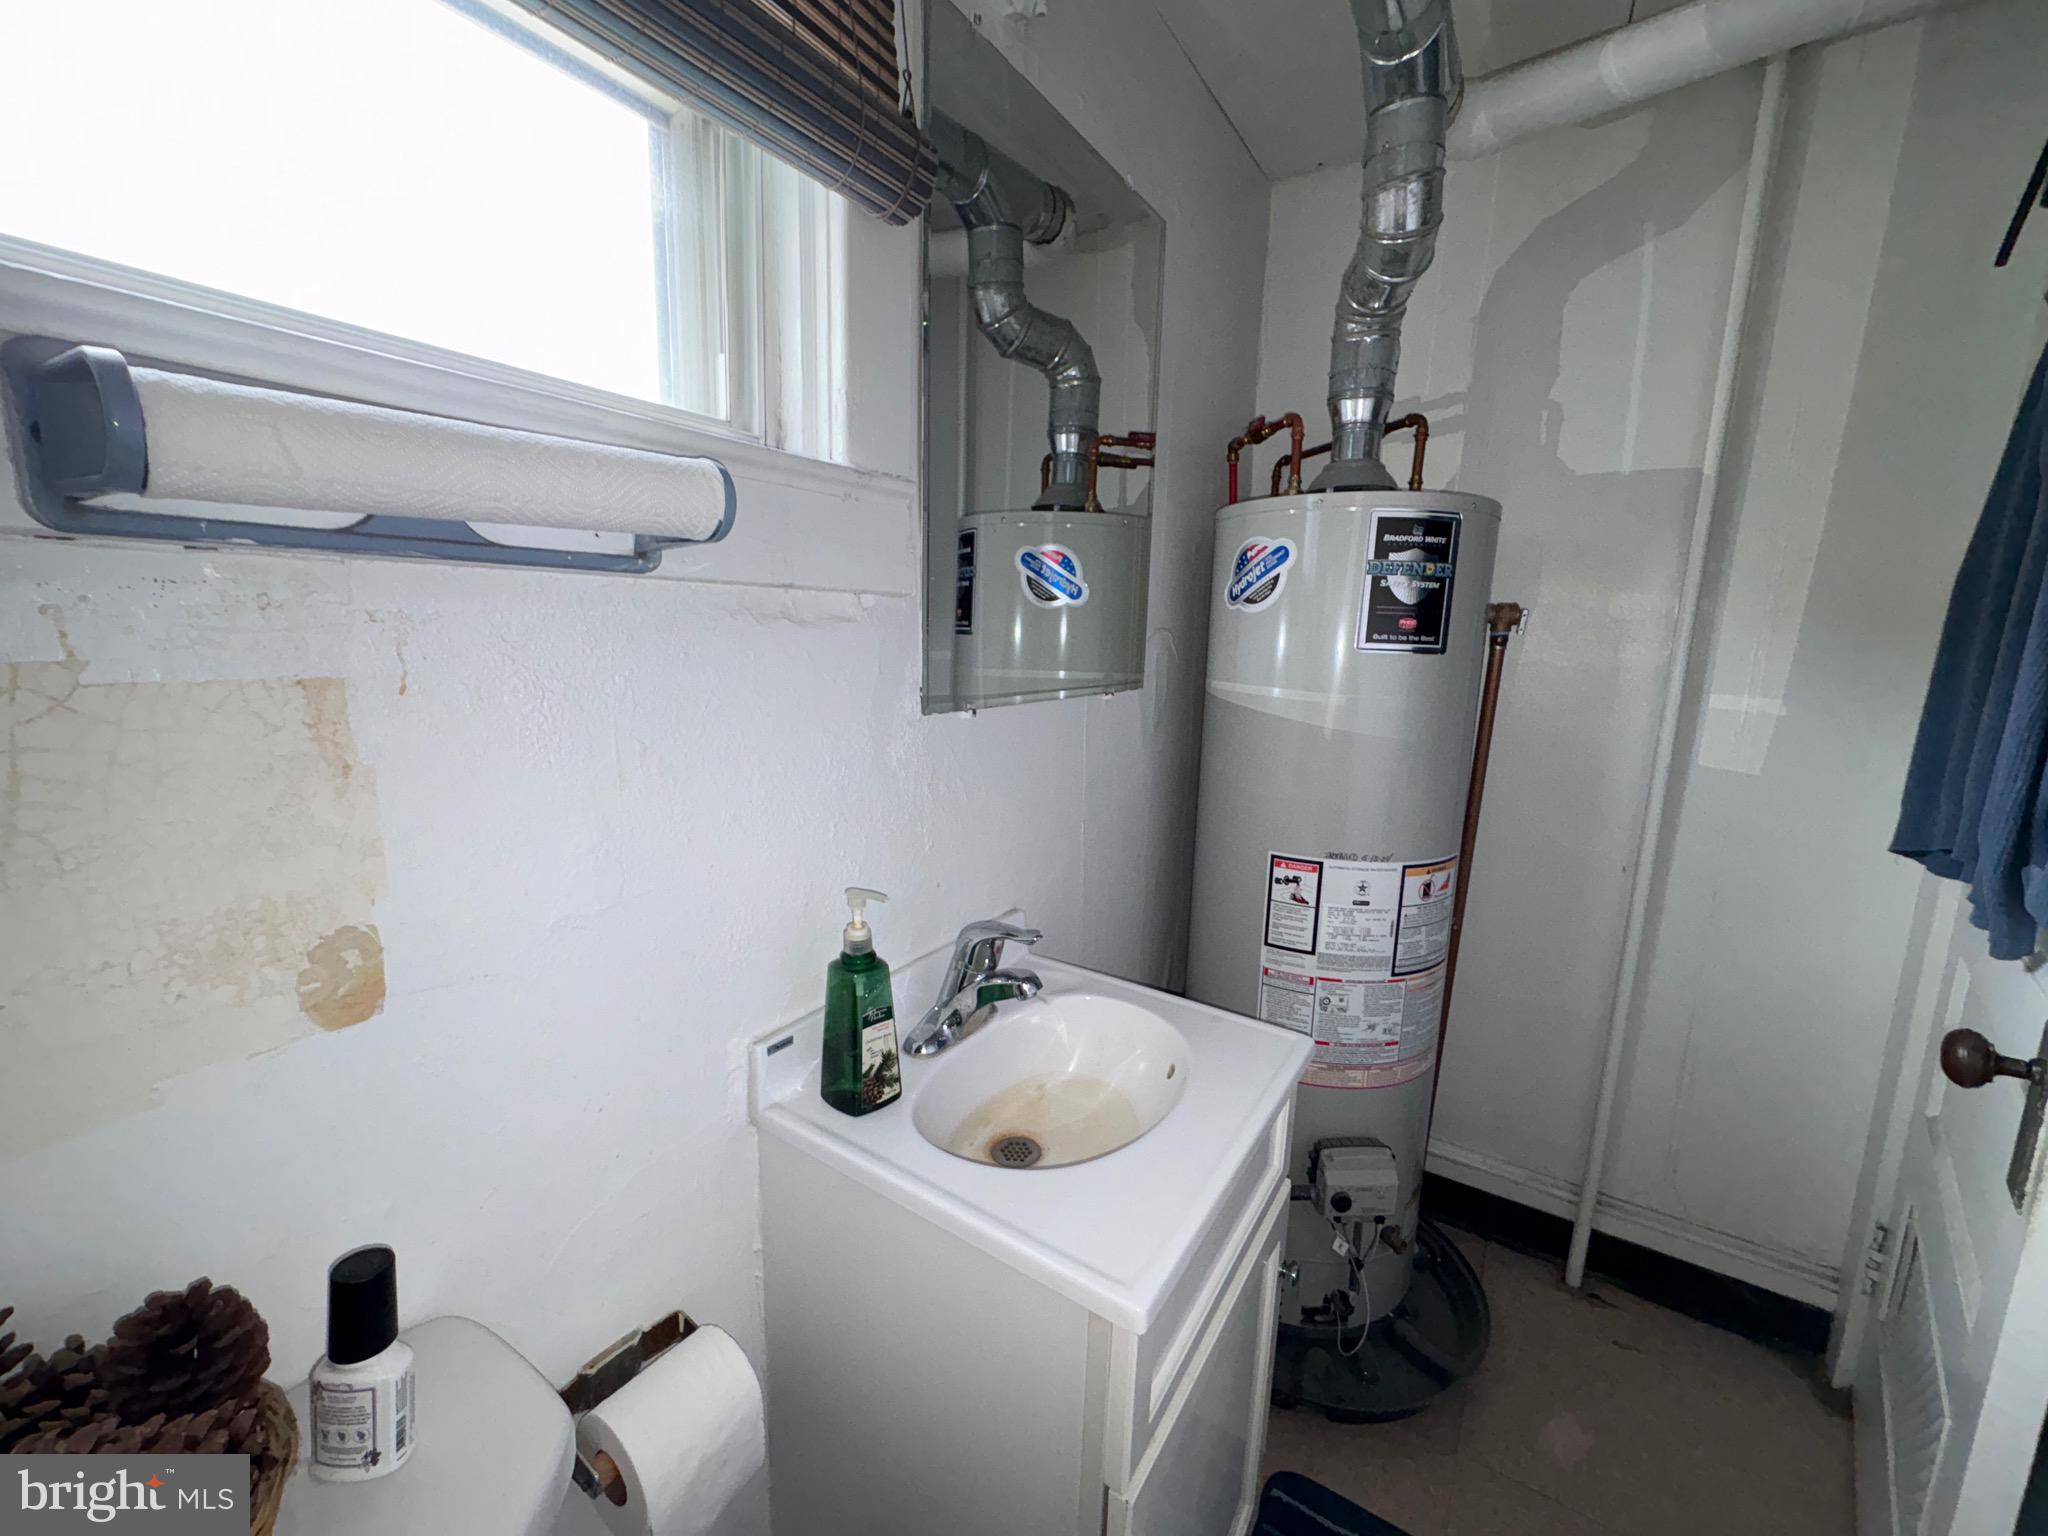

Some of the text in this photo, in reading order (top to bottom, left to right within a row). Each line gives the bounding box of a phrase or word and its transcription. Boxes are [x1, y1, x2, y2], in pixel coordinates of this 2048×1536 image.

[1383, 534, 1447, 544] BRADFORD WHITE
[1367, 560, 1453, 577] DEFENDER
